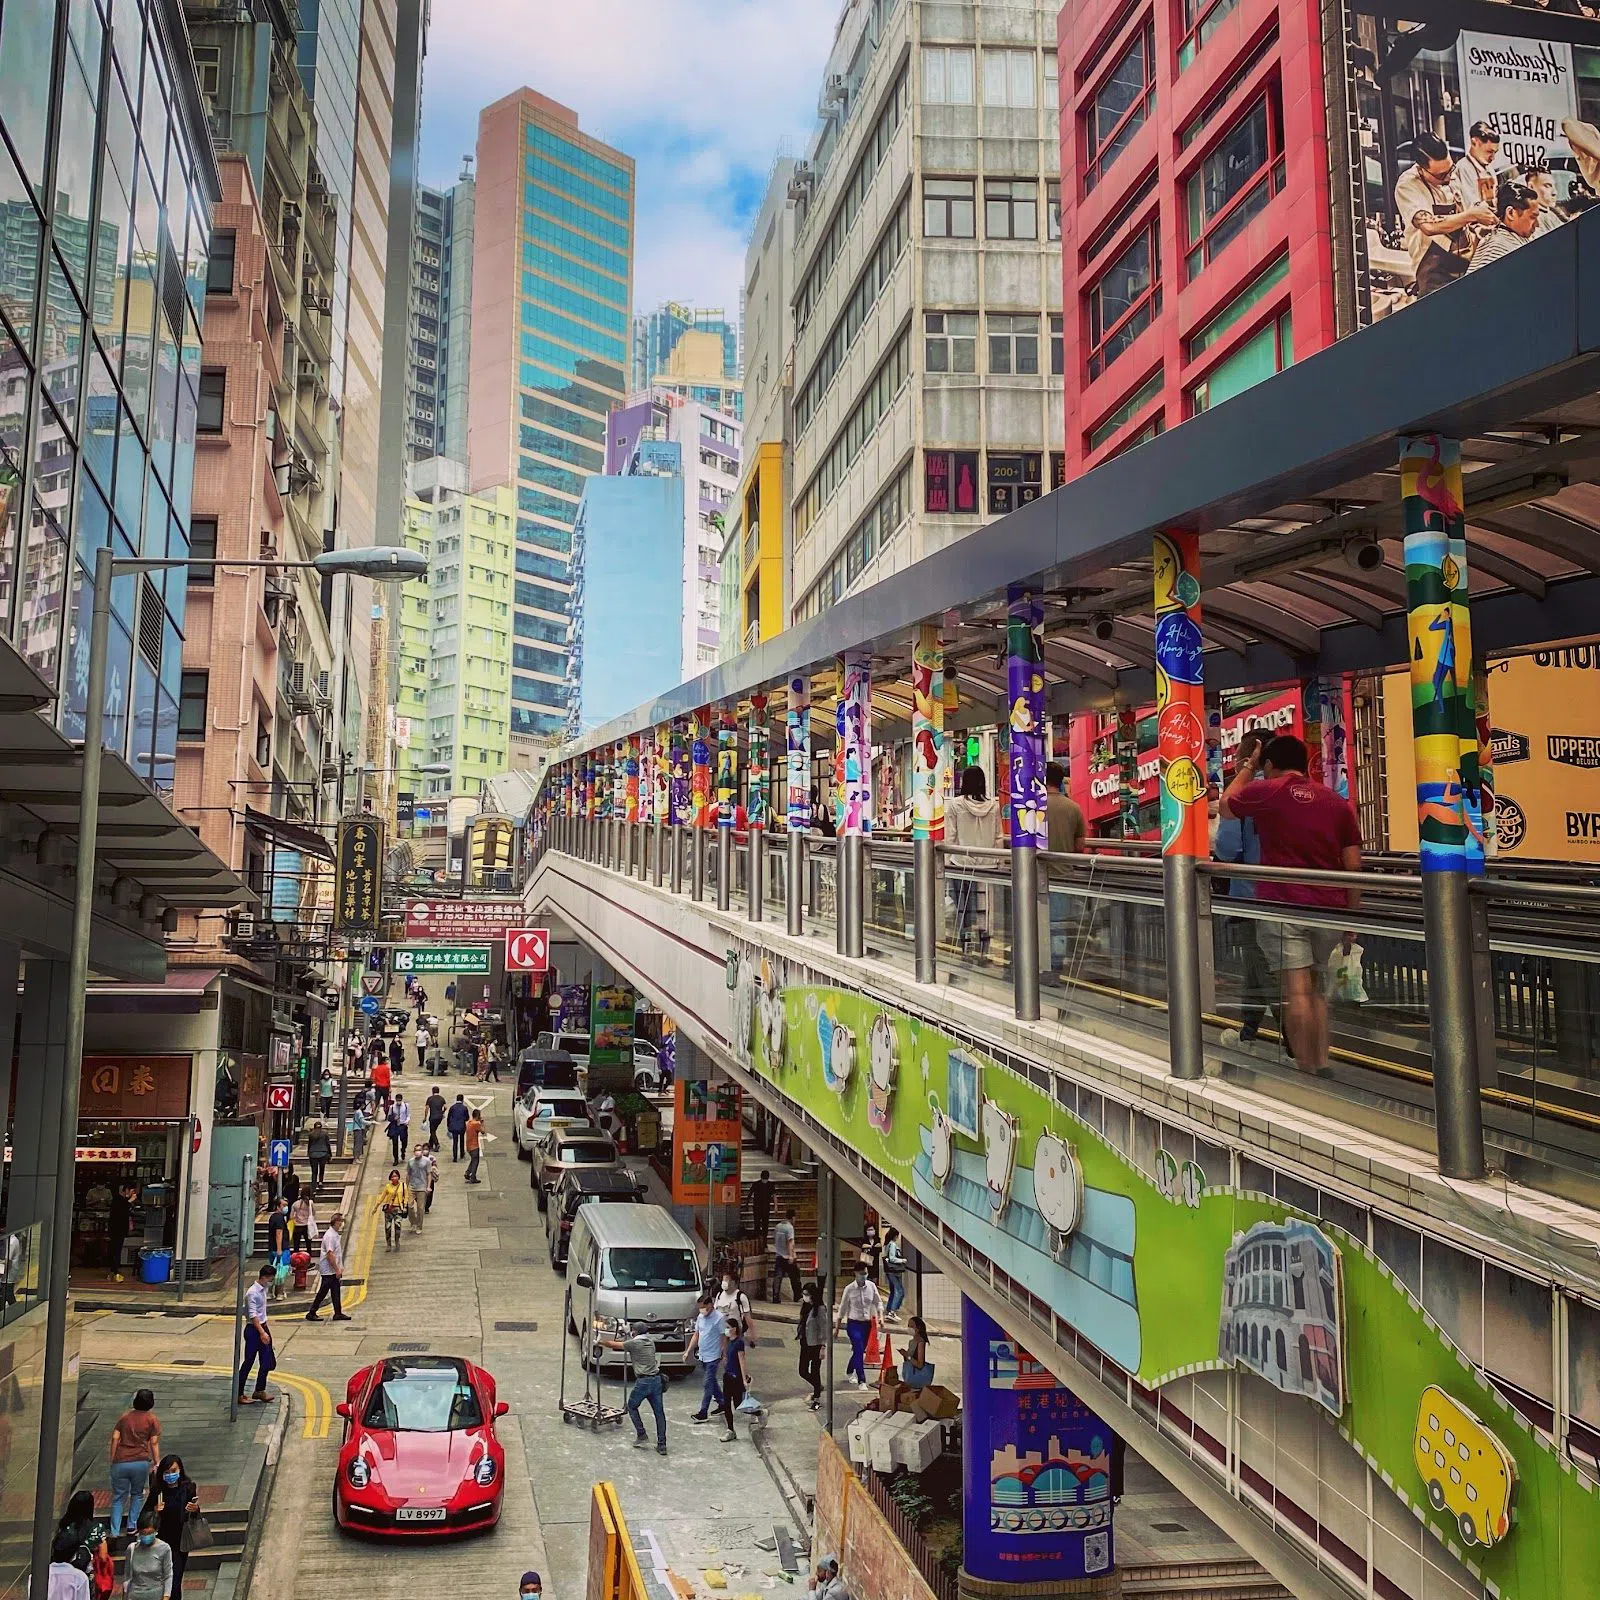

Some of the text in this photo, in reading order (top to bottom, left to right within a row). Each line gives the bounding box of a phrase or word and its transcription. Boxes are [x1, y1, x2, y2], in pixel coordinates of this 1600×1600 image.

[994, 467, 1018, 477] 200+
[354, 826, 368, 868] 春回堂
[518, 936, 541, 964] K
[274, 1090, 288, 1105] K
[400, 1510, 443, 1519] LV 8997
